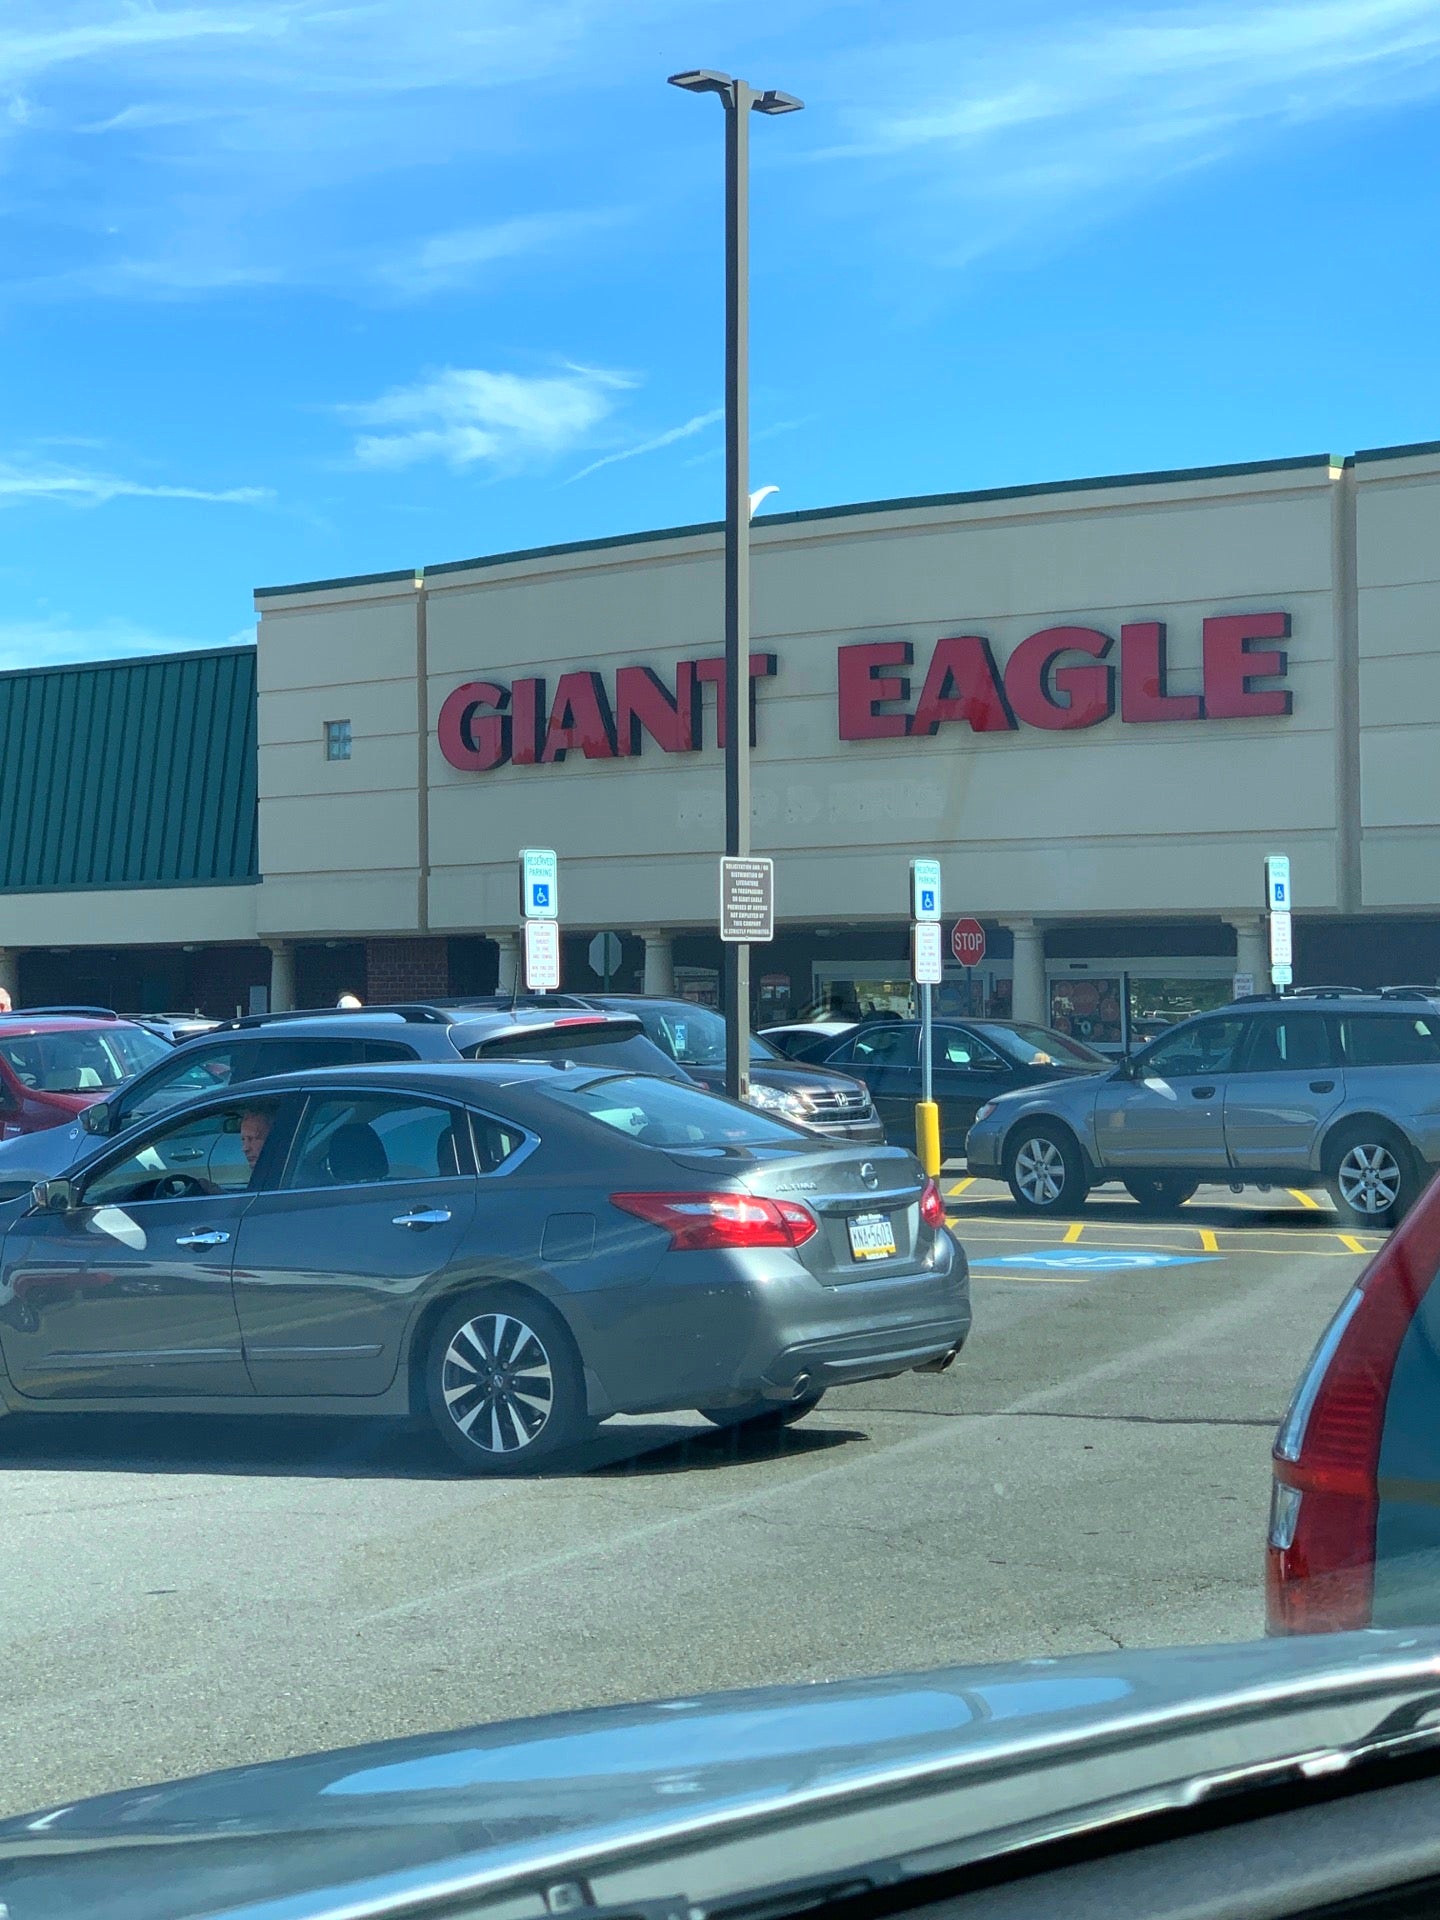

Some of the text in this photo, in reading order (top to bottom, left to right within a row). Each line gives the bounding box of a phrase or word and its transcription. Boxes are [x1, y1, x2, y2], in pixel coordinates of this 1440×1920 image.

[438, 612, 1293, 771] GIANT EAGLE
[528, 856, 553, 866] RESERVED
[528, 867, 552, 877] PARKING
[954, 932, 983, 951] STOP
[776, 1181, 817, 1191] ALTIMA
